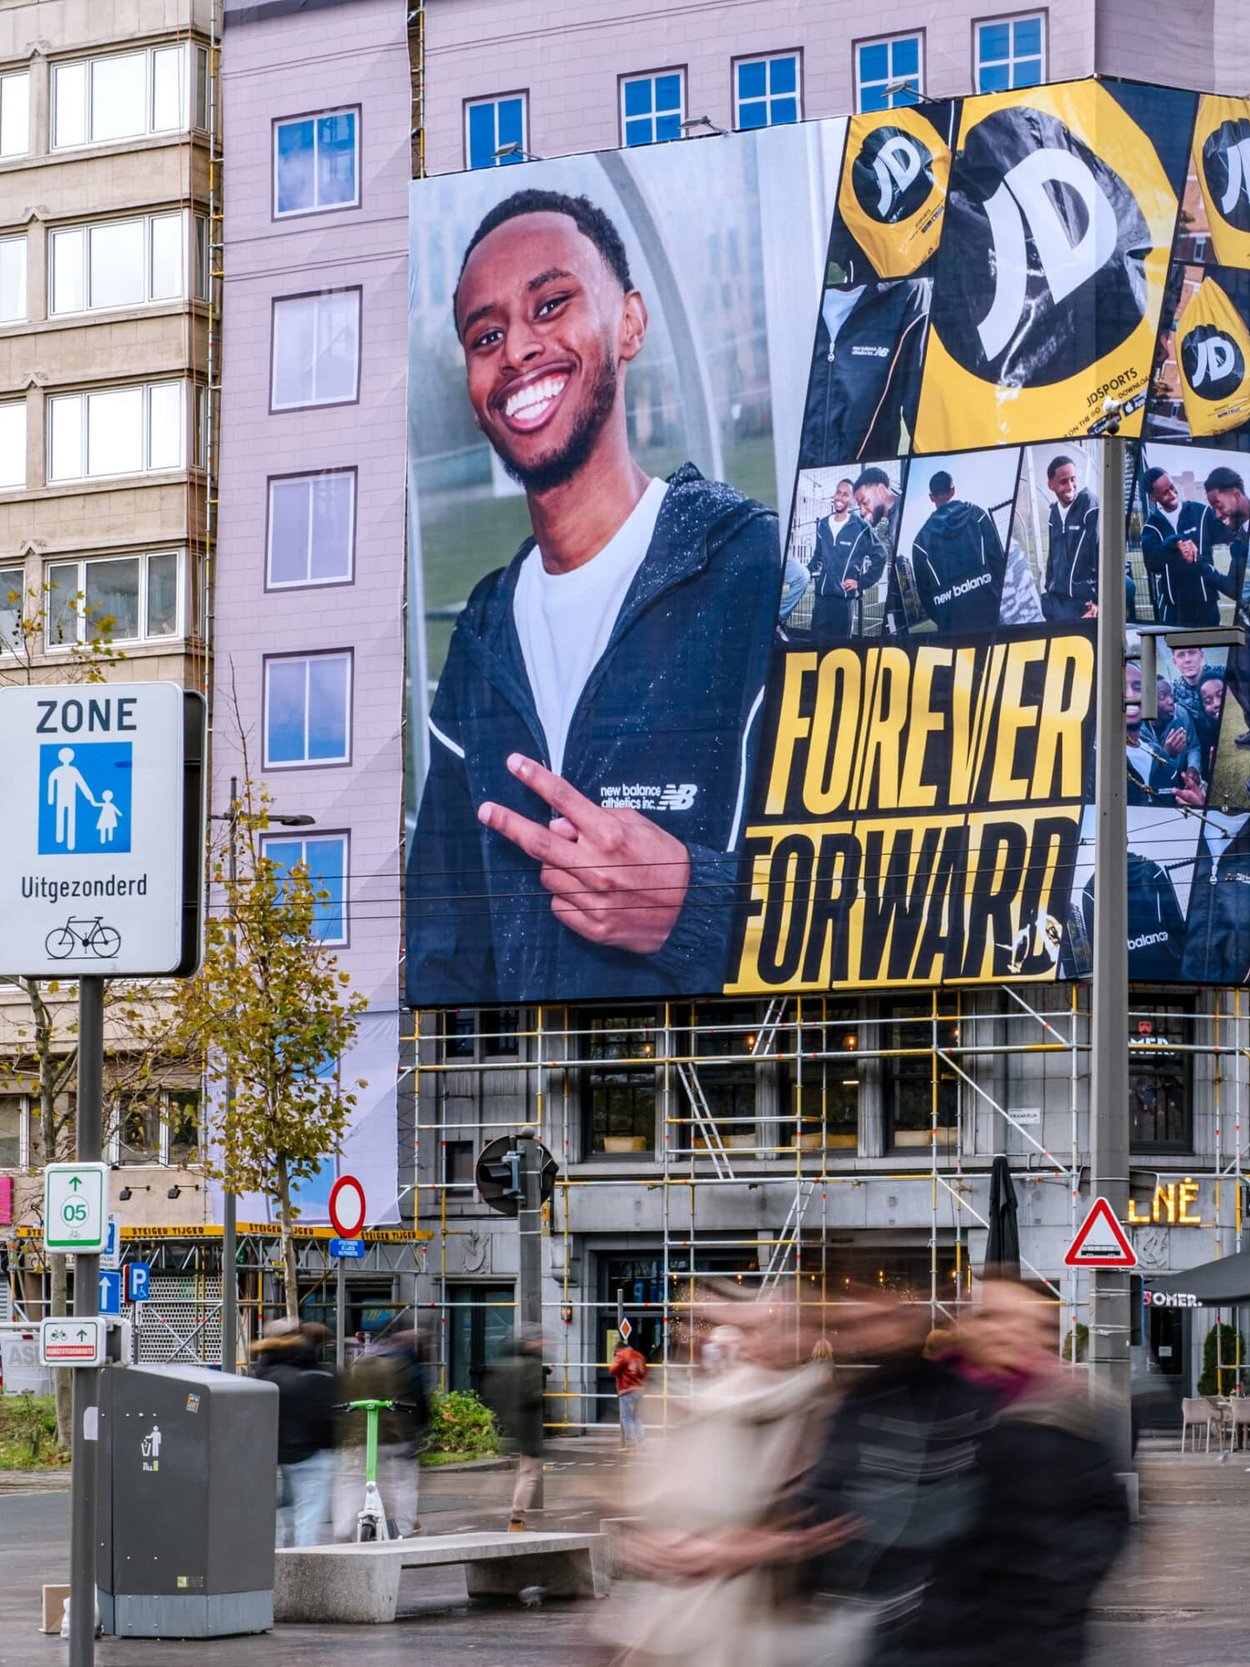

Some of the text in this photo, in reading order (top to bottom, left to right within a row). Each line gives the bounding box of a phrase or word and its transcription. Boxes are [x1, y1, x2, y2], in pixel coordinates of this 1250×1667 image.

[873, 136, 921, 217] JD
[977, 148, 1118, 361] JD
[1191, 336, 1235, 388] JD
[1086, 367, 1138, 408] JDSPORTS
[1117, 375, 1151, 399] DOWNLOA
[933, 589, 952, 606] new
[36, 698, 138, 734] ZONE
[765, 635, 1095, 816] FOREVER
[600, 786, 621, 797] new
[622, 783, 661, 797] balance
[601, 797, 641, 809] athletics
[21, 873, 148, 904] Uitgezonderd
[728, 816, 1081, 986] FORWARD
[63, 1204, 87, 1221] 05
[132, 1226, 204, 1235] STEIGER TIJGER
[132, 1269, 146, 1295] P
[1152, 1292, 1203, 1307] OMER.
